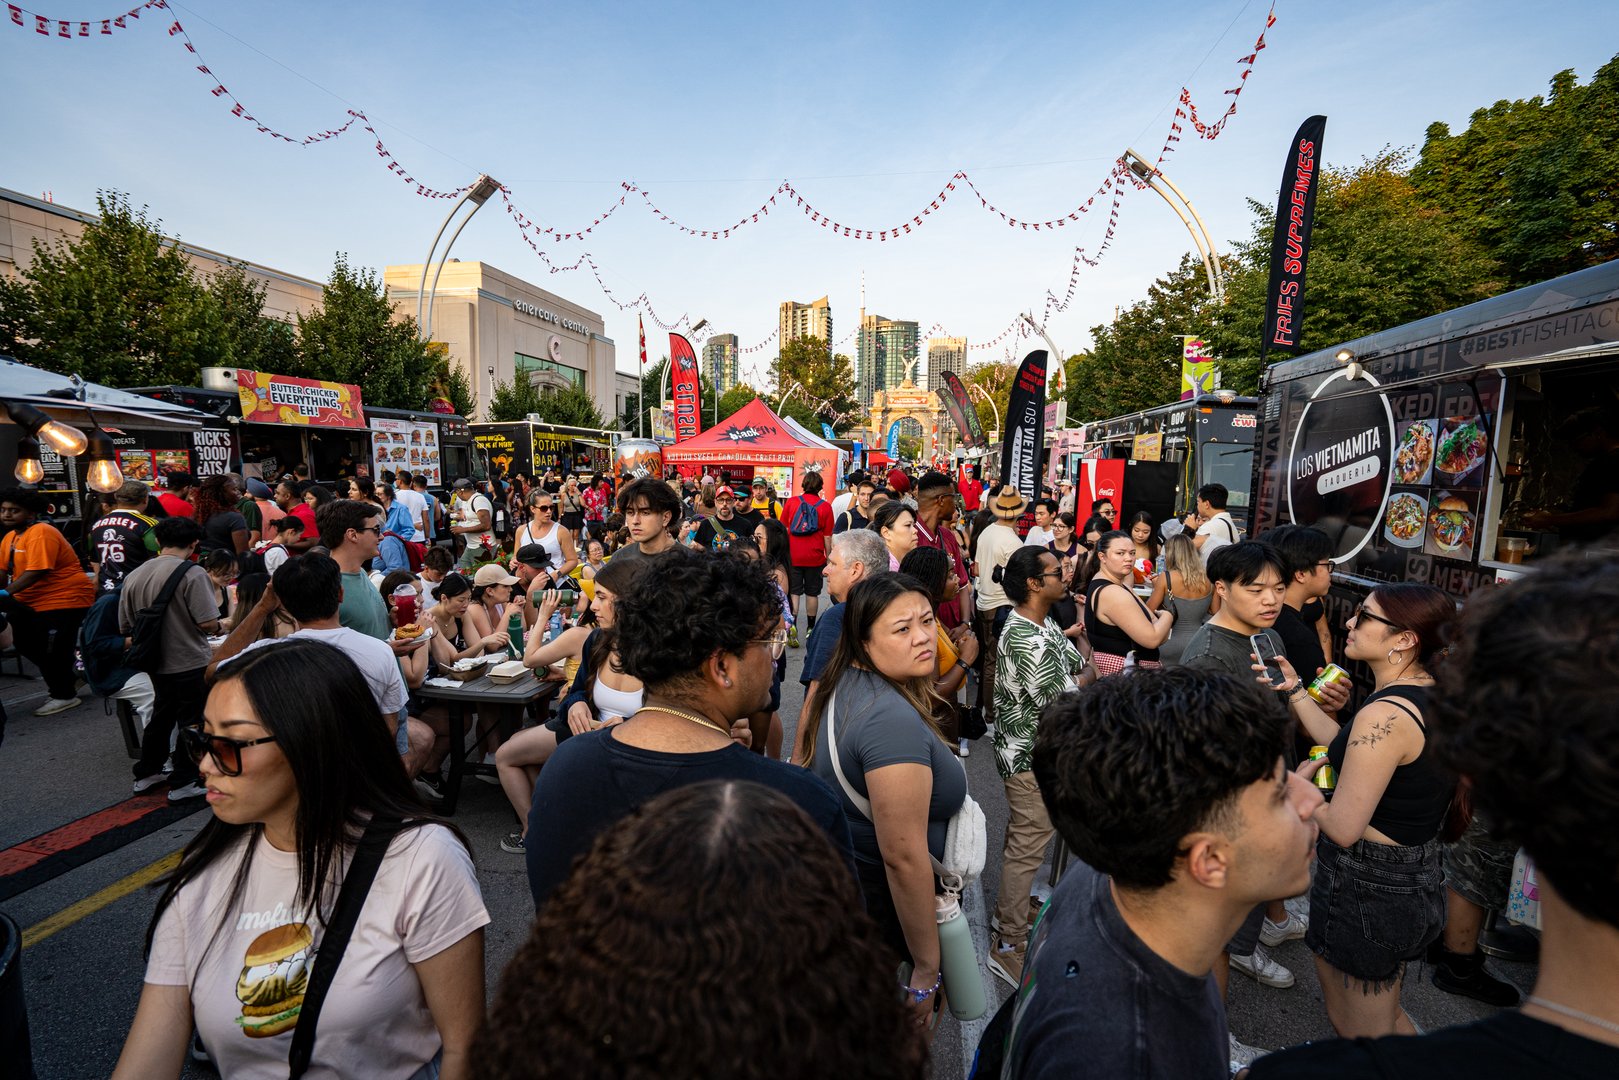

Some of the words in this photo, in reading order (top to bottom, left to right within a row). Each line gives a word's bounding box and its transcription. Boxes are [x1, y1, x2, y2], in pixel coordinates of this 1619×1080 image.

[1284, 138, 1314, 275] SUPREMES
[514, 299, 559, 324] enercare
[562, 316, 589, 336] centre
[1273, 280, 1299, 346] FRIES
[1463, 306, 1619, 356] #BESTFISHTAC
[271, 383, 303, 394] BUTTER
[305, 387, 339, 398] CHICKEN
[272, 392, 341, 409] EVERYTHING,
[300, 405, 319, 416] EH!
[1024, 400, 1037, 425] LOS
[193, 431, 231, 446] RICK'S
[728, 428, 759, 441] black
[195, 446, 227, 461] GOOD
[1011, 436, 1020, 484] TAQUERI
[1296, 456, 1313, 480] LOS
[1314, 427, 1380, 473] VIETNAMITA
[197, 460, 224, 475] EATS
[1325, 463, 1372, 487] TAQUERIA
[97, 543, 125, 563] 76
